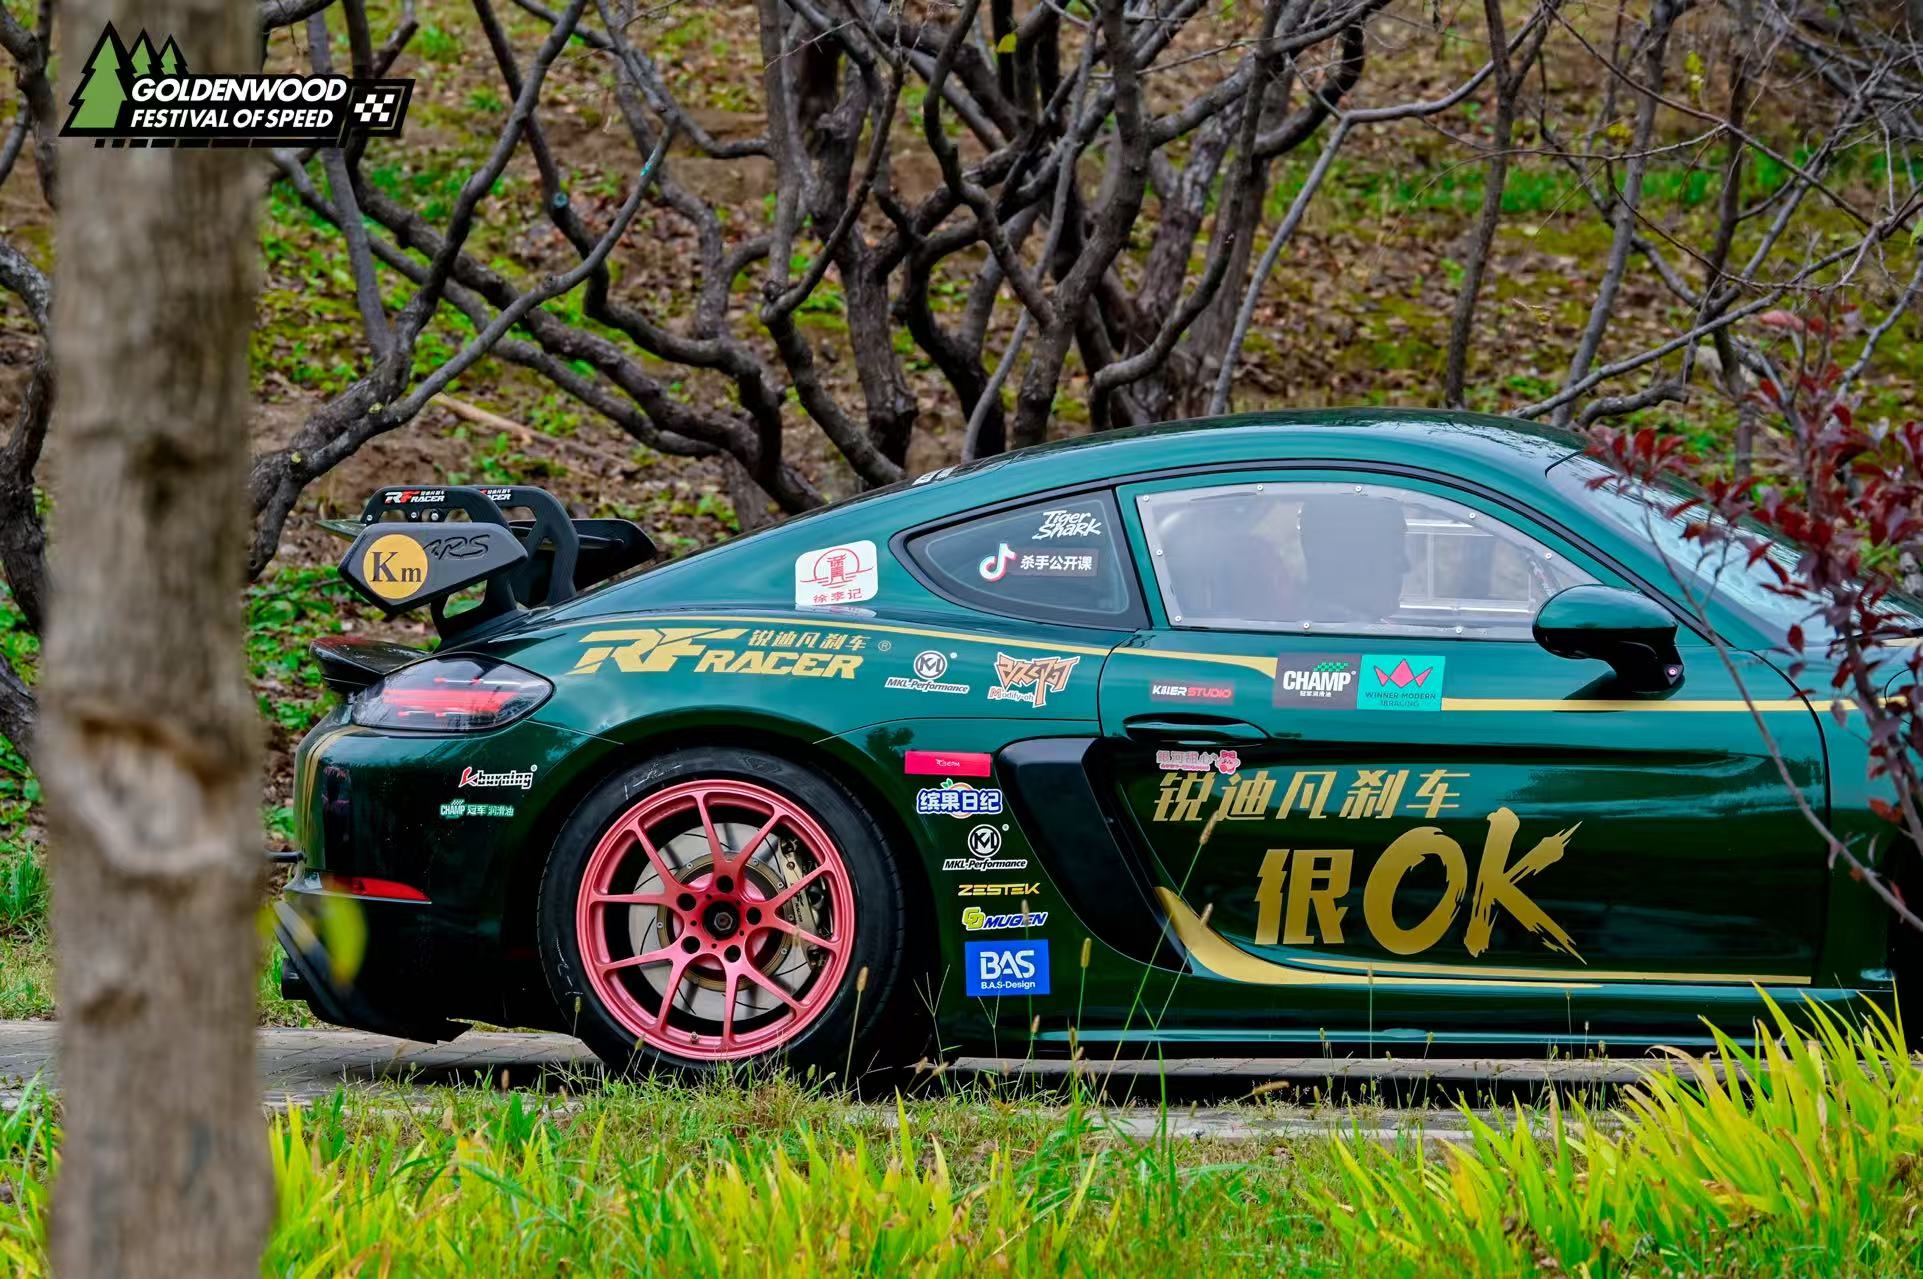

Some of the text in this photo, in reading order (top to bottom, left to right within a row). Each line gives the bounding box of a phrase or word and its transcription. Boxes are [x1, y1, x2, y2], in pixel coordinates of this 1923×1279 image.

[410, 495, 445, 503] RACER
[1043, 510, 1092, 526] Tiger
[369, 551, 423, 583] Km
[1020, 554, 1093, 571] 杀手公开课
[747, 629, 872, 651] 锐迪凡刹车
[693, 649, 864, 680] RACER
[886, 677, 969, 694] MKL-Performance
[1282, 670, 1352, 692] CHAMP
[1187, 687, 1232, 698] STUDIO
[1365, 691, 1436, 700] WINNER MODERN
[918, 790, 1001, 813] 缤果日纪
[1152, 769, 1471, 822] 锐迪凡刹车
[440, 805, 466, 816] CHAMP
[943, 858, 1028, 871] MKL-Performance
[957, 882, 1041, 896] ZESTEK
[979, 949, 1036, 980] BAS
[981, 980, 1036, 990] B.A.S-Design
